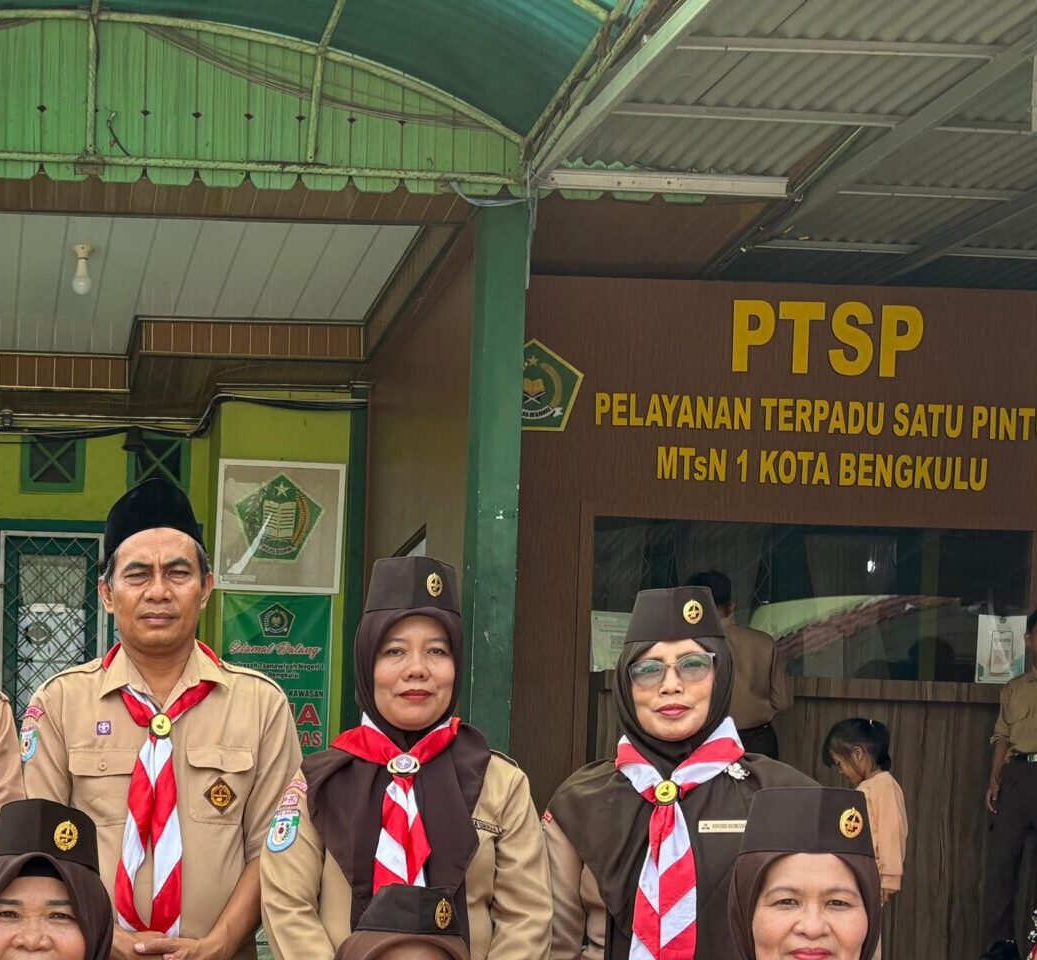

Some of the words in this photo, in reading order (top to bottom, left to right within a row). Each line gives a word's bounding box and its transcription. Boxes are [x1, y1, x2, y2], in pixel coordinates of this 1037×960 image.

[731, 299, 924, 378] PTSP
[595, 392, 751, 431] PELAYANAN
[760, 398, 885, 436] TERPADU
[892, 402, 964, 439] SATU
[971, 406, 1037, 441] PINT
[657, 446, 727, 483] MTsN
[736, 449, 748, 483] 1
[759, 450, 831, 485] KOTA
[838, 452, 988, 492] BENGKULU
[288, 690, 324, 698] KAWASAN
